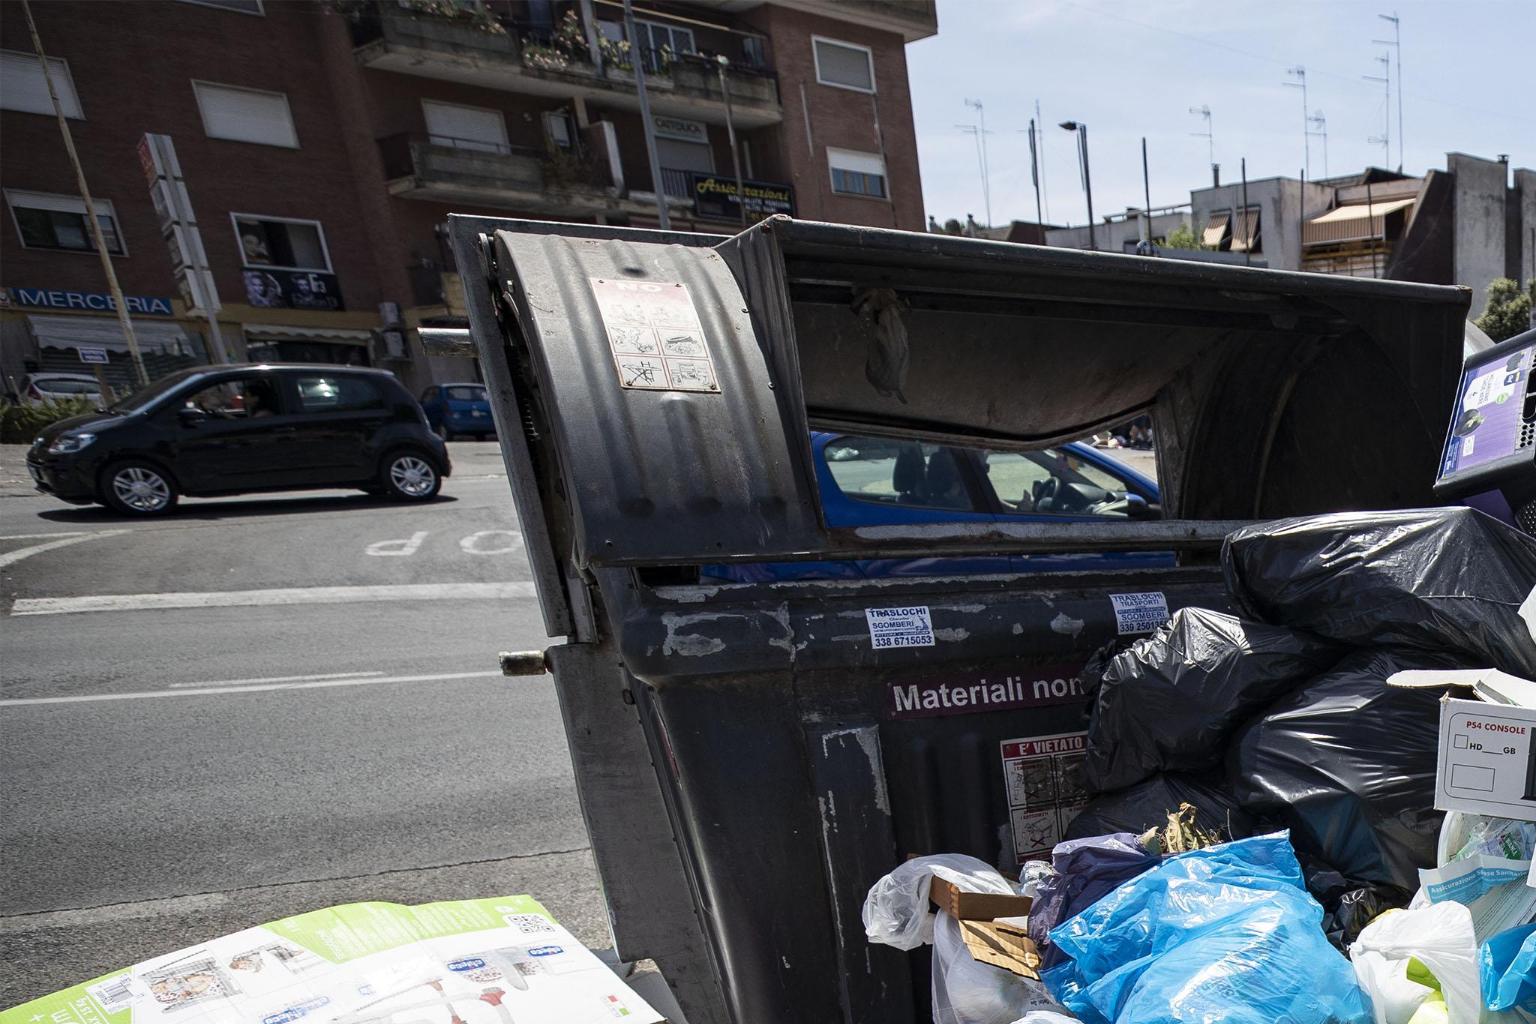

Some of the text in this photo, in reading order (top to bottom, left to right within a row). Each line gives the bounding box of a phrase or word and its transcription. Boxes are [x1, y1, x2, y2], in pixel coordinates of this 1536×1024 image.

[697, 178, 790, 201] Assicrazioni
[1112, 593, 1163, 602] TRASLOCHI
[869, 608, 926, 617] TRASLOCHI
[1122, 612, 1165, 620] SGOMBERI
[872, 621, 914, 629] SGOMBERI
[875, 635, 932, 647] 338 6715053
[893, 676, 1085, 712] Materiali non
[1466, 721, 1526, 735] PS4 CONSOLE
[1034, 737, 1082, 754] VIETATO
